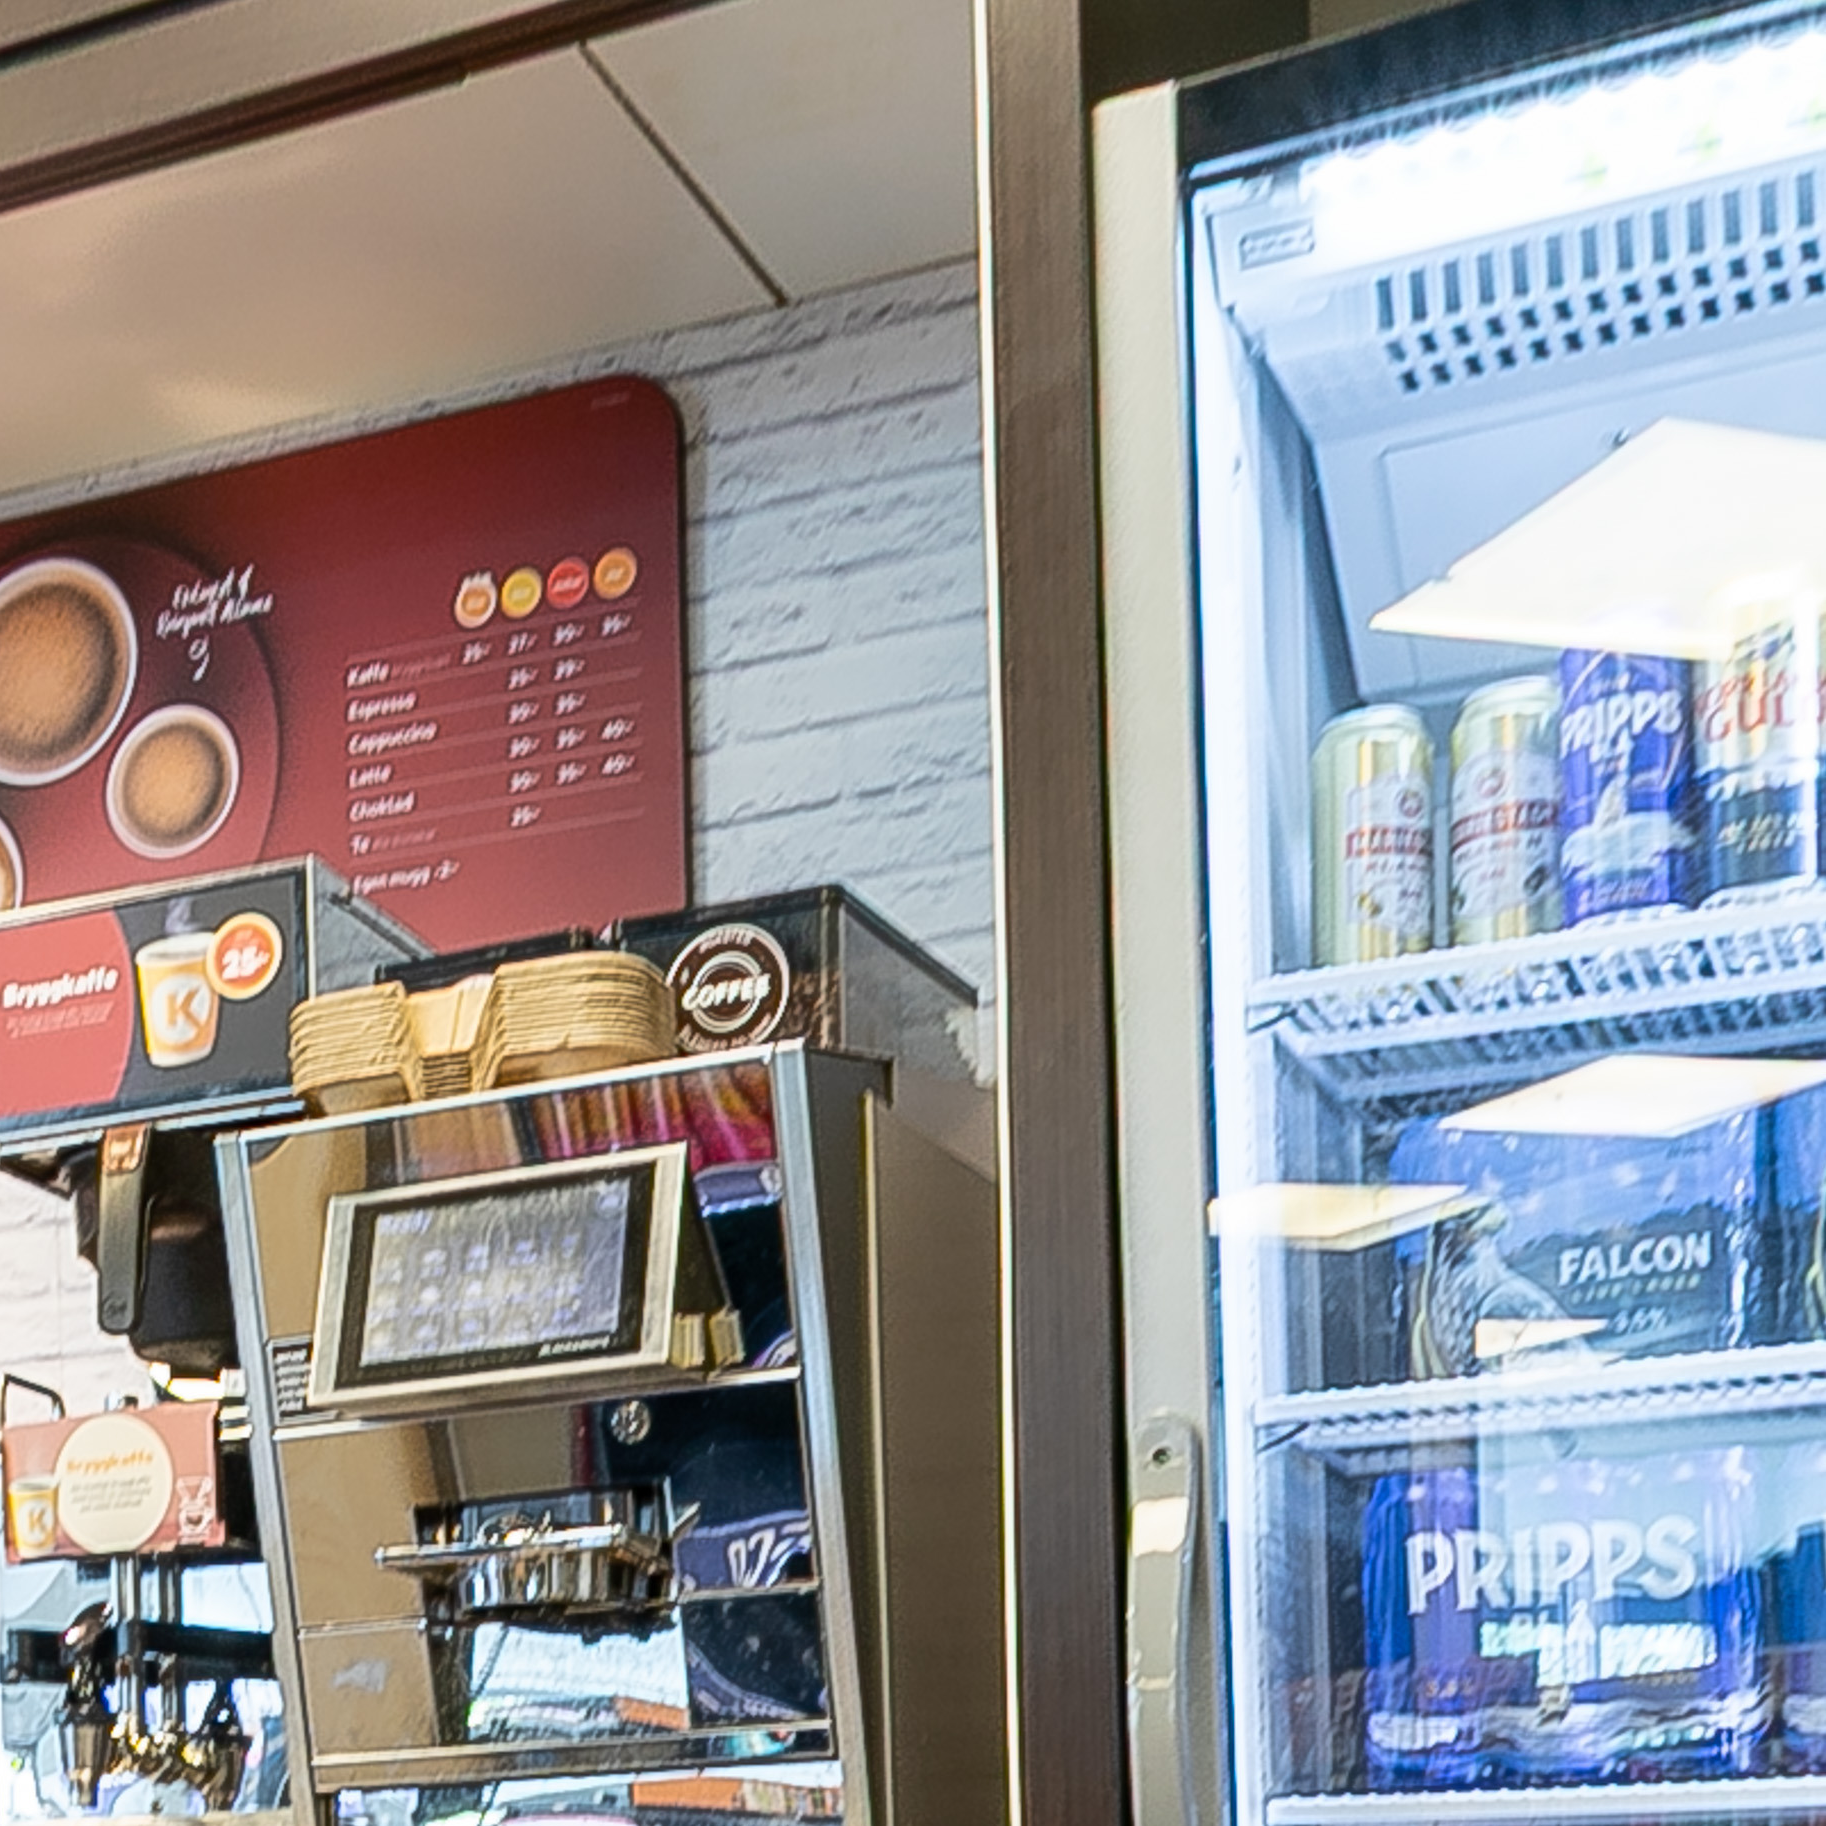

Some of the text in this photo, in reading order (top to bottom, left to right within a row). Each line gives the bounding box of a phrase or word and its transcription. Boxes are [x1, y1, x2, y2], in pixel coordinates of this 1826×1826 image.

[347, 661, 390, 688] Kaffe
[2, 965, 119, 1010] Bryggkaffe
[681, 973, 771, 1011] COFFEE
[1558, 1230, 1713, 1287] FALCON
[1404, 1514, 1700, 1615] PRIPPS
